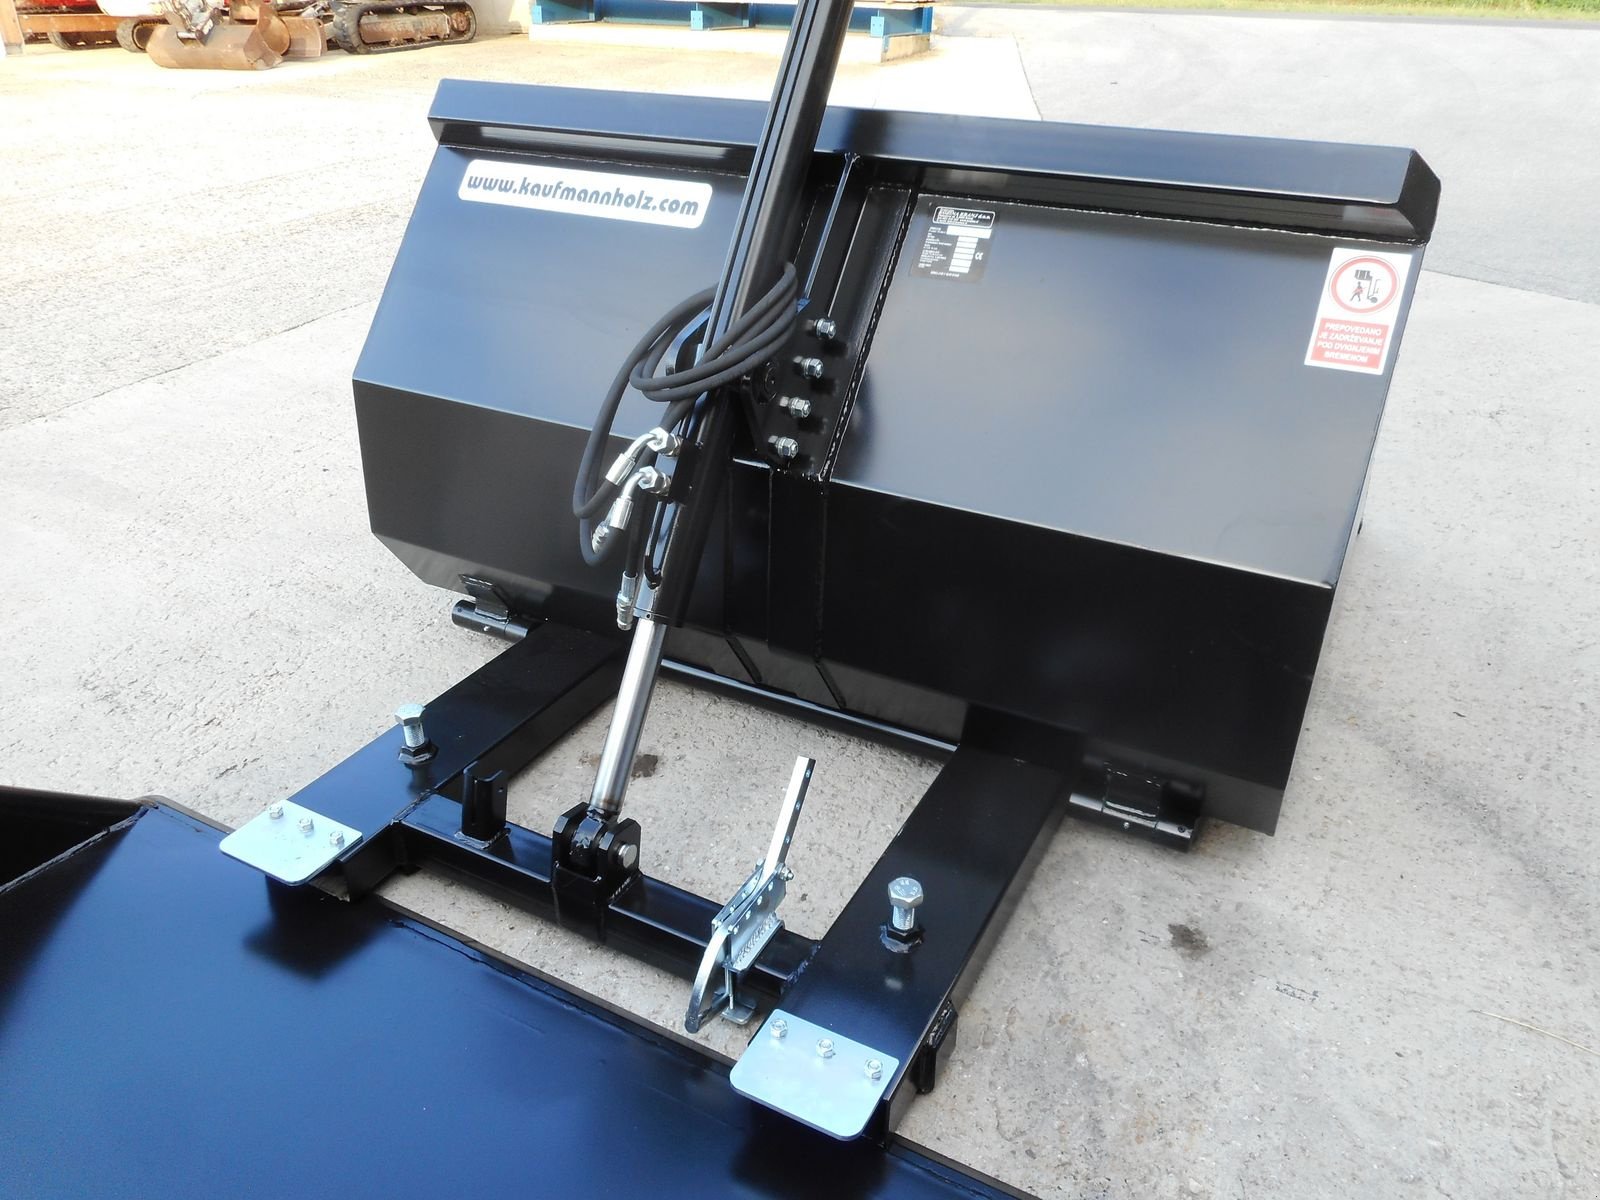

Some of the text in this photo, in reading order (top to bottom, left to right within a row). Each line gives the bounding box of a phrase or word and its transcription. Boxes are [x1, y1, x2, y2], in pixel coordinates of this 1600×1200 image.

[467, 175, 699, 216] www.kaufmannholz.com
[1325, 323, 1382, 335] PREPOVEDANO
[1317, 341, 1333, 349] POD
